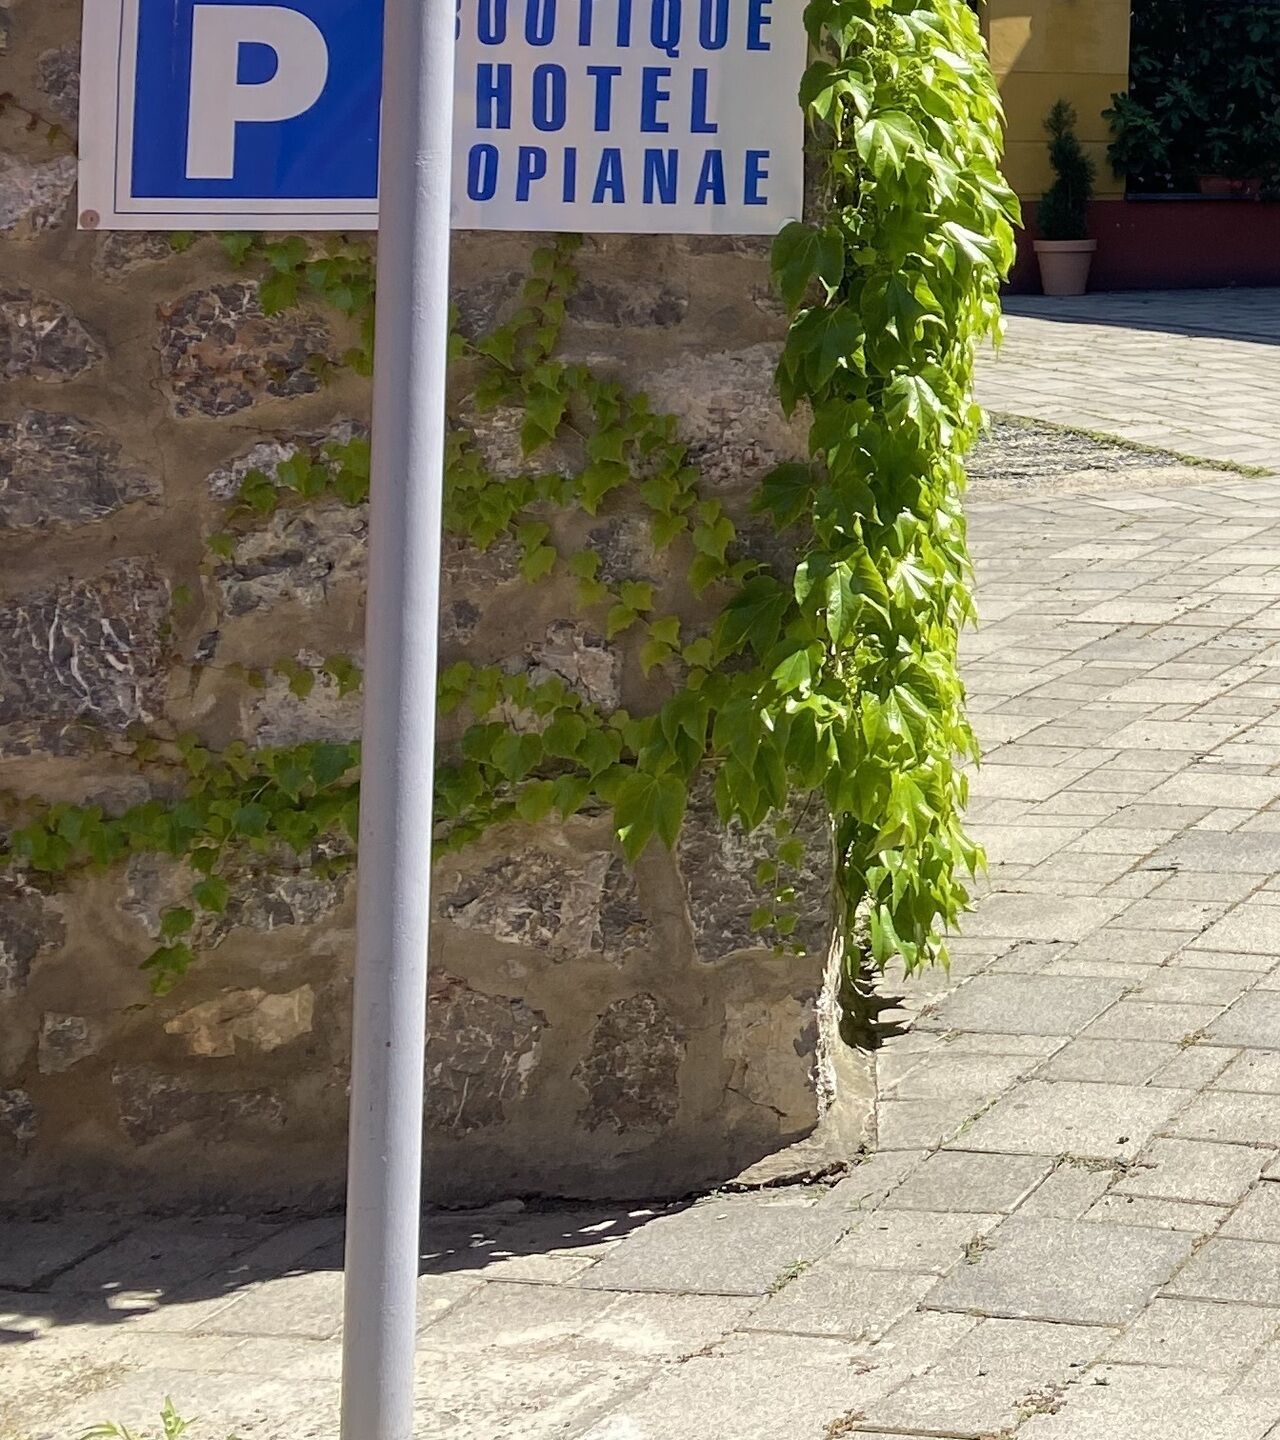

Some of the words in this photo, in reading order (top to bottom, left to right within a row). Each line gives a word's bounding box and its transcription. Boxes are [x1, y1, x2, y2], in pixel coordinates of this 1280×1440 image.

[186, 4, 329, 180] P
[476, 63, 718, 134] HOTEL
[466, 143, 769, 205] OPIANAE
